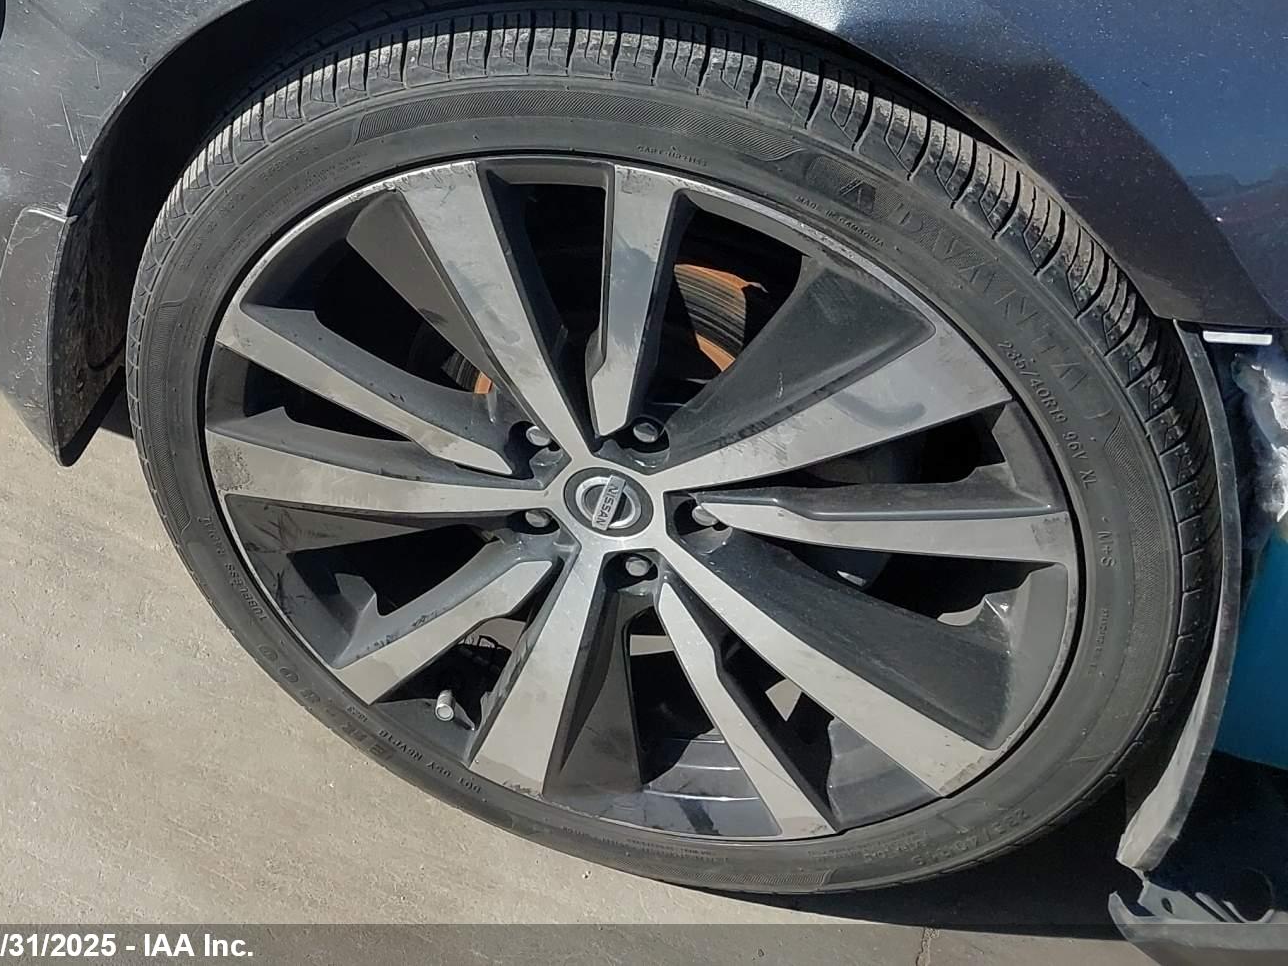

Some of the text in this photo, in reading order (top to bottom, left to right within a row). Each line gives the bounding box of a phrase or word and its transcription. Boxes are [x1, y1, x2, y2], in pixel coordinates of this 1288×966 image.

[996, 338, 1098, 489] 235/40R19 96V XL
[595, 483, 620, 525] NISSAN
[1096, 528, 1119, 570] M+S
[224, 562, 269, 622] TUBELESS
[456, 776, 482, 794] DOT
